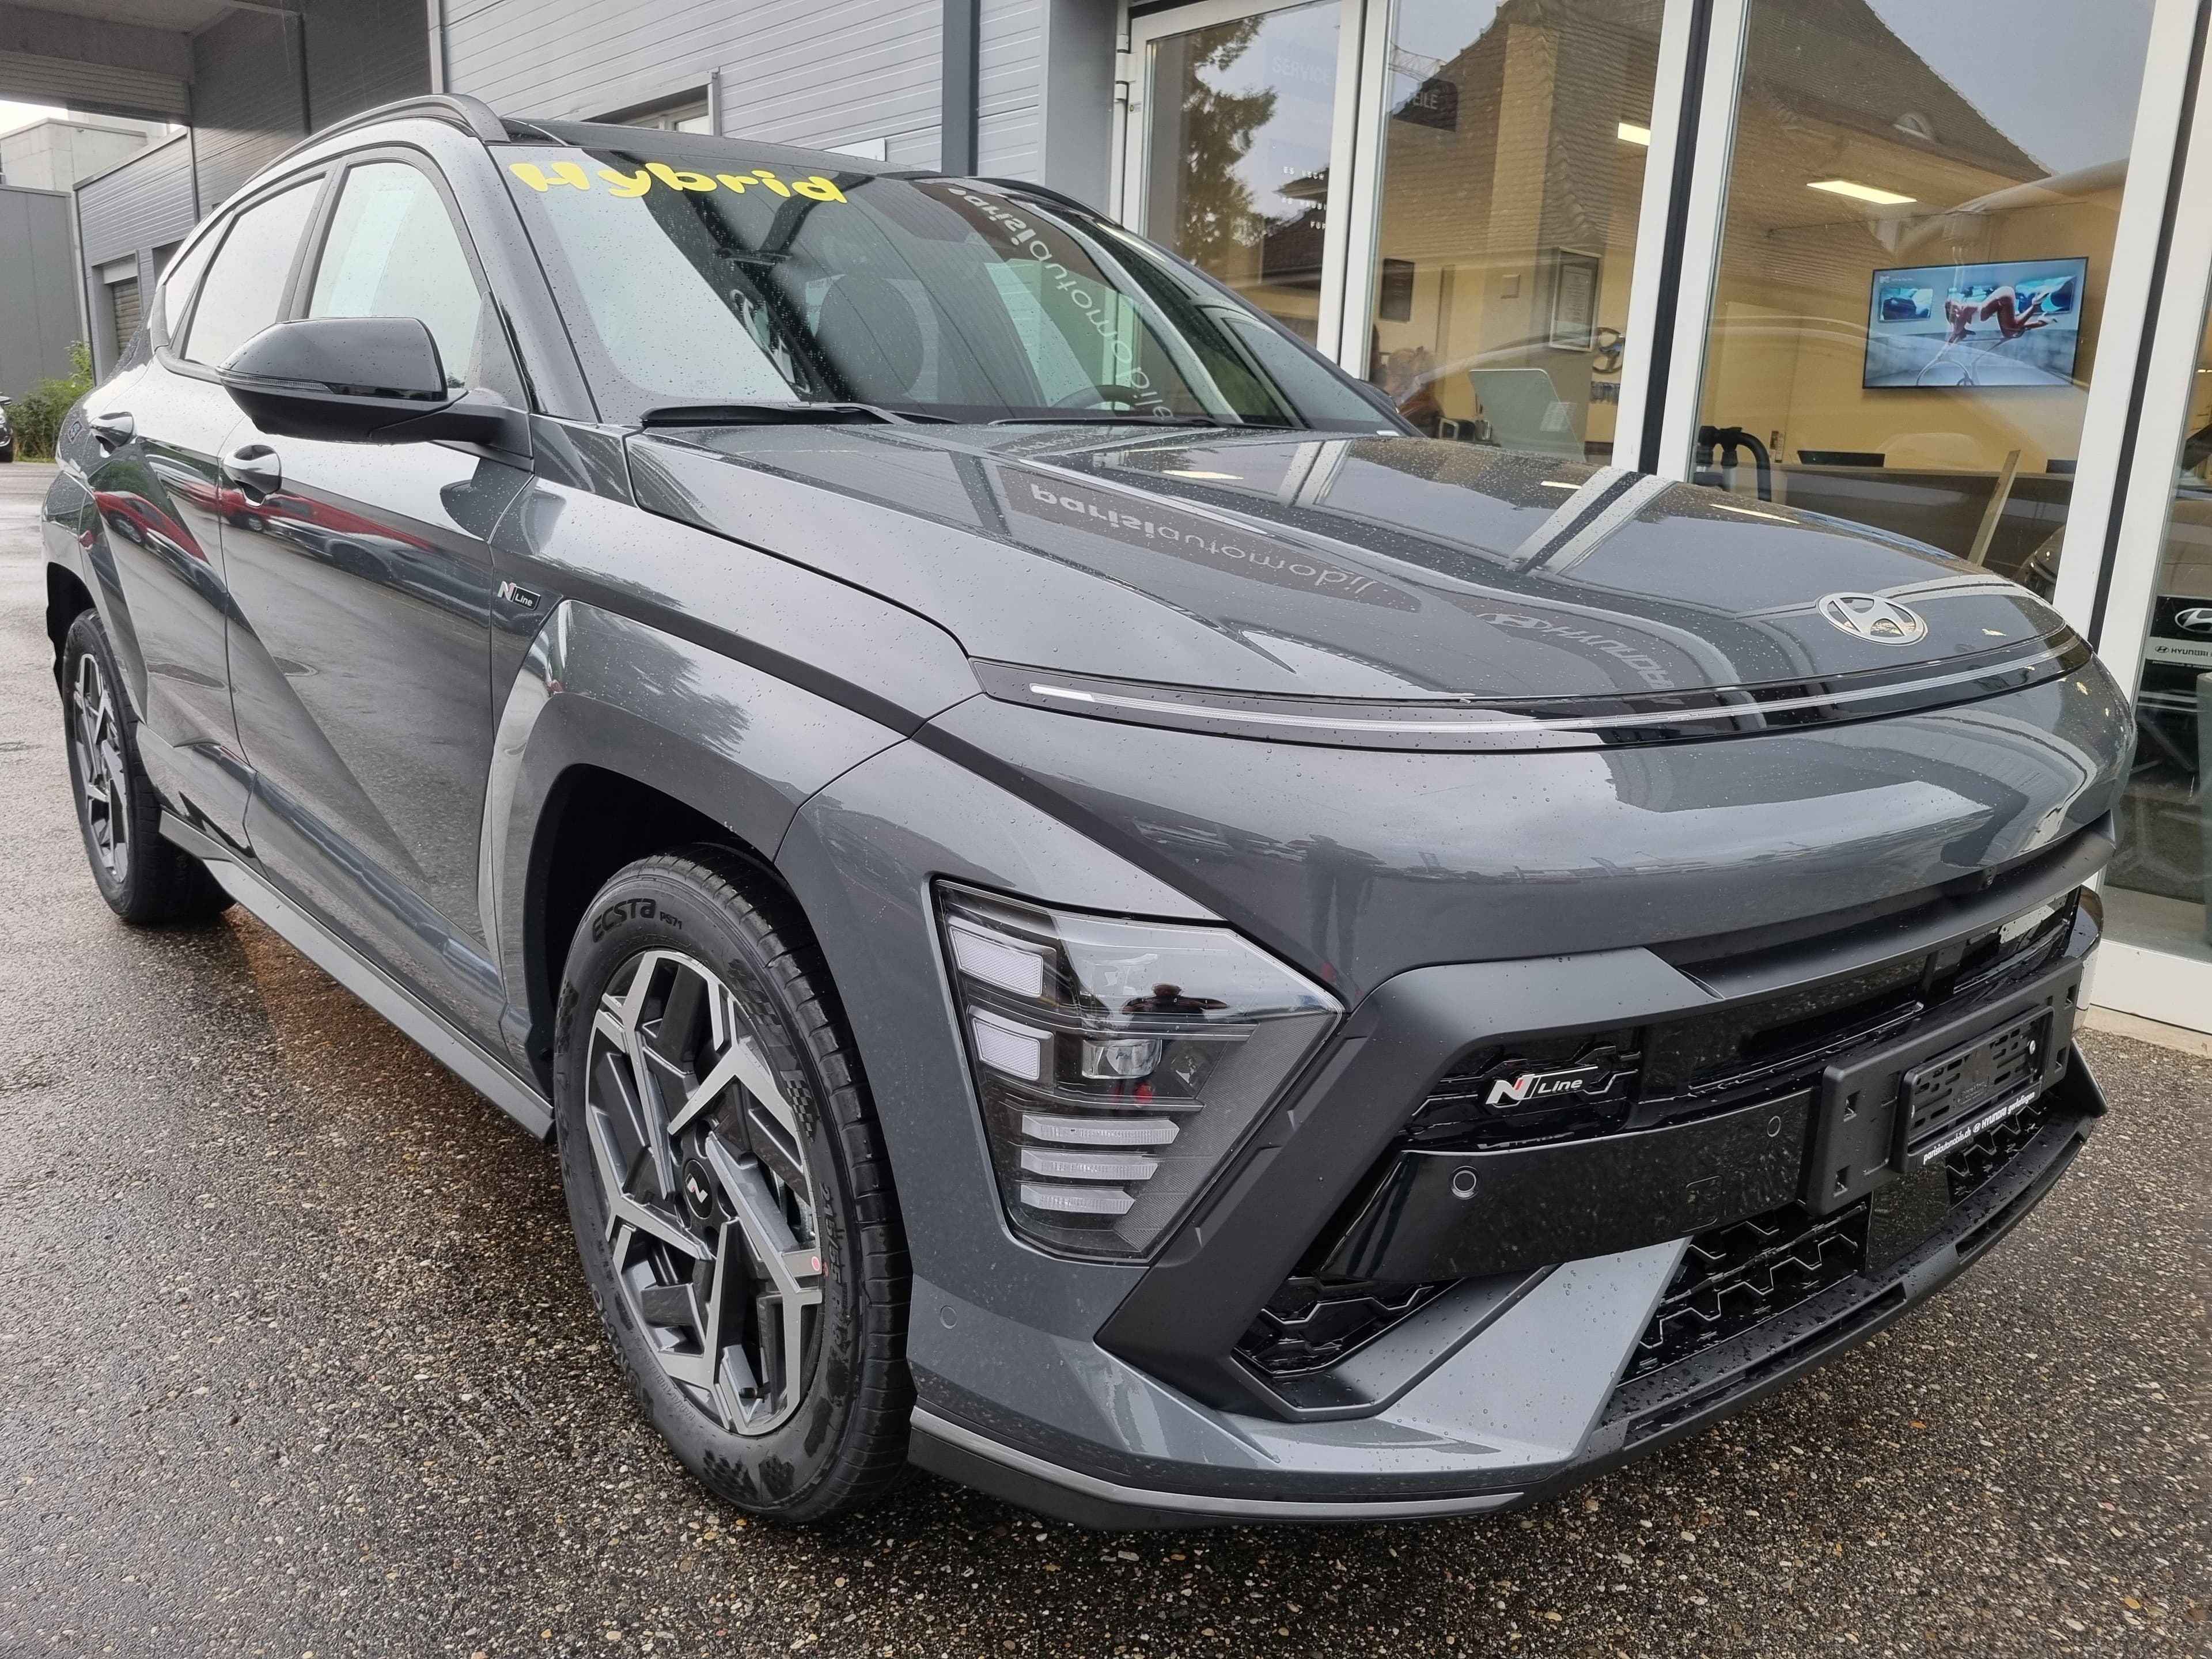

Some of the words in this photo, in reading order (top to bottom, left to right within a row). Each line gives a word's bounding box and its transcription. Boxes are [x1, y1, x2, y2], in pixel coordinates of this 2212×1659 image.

[1272, 56, 1333, 85] SERVICE
[509, 162, 848, 203] Hybrid
[515, 593, 533, 606] Line
[1537, 1079, 1583, 1094] Line
[1981, 1107, 2008, 1129] HYUNDAI
